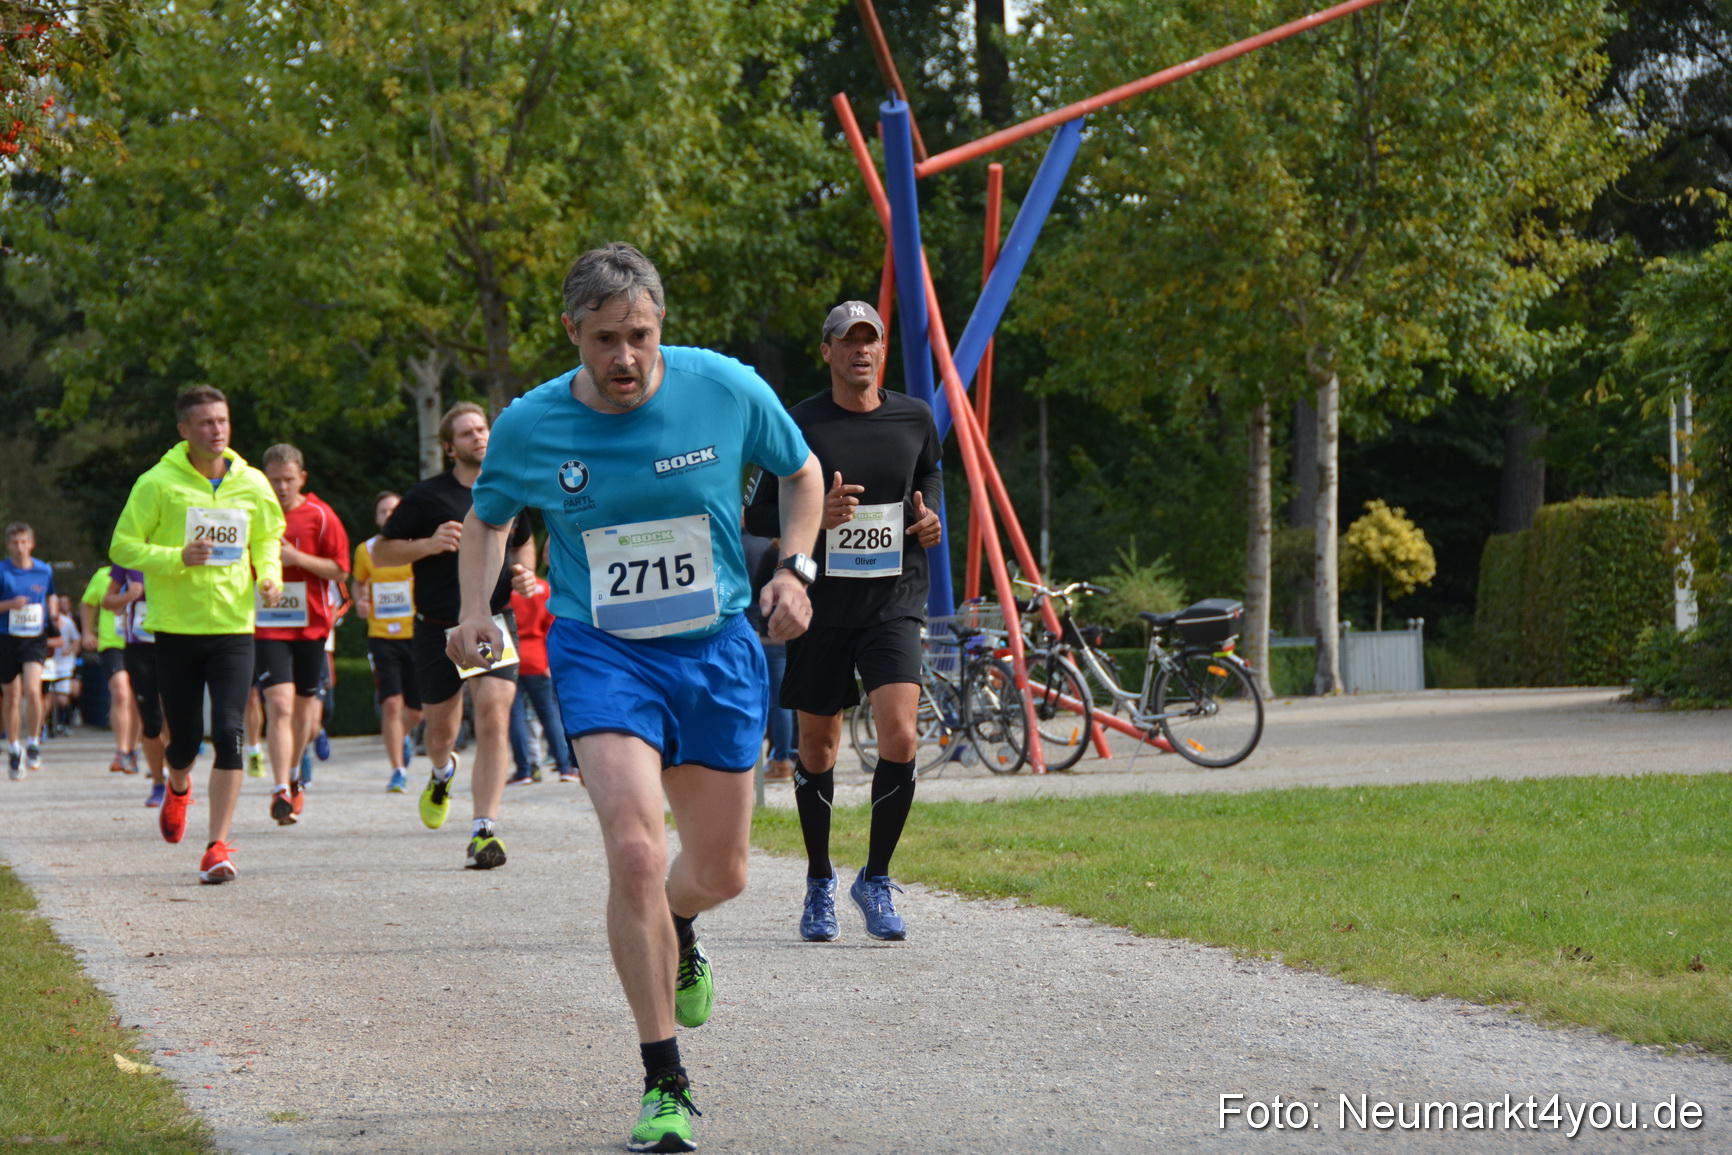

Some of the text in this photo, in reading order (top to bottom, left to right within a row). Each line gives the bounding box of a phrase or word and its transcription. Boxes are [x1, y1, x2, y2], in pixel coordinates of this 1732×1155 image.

[654, 446, 717, 474] BOCK
[563, 495, 595, 508] PARTL
[194, 525, 238, 543] 2468
[631, 530, 675, 545] BOCK
[838, 526, 893, 550] 2286
[855, 557, 877, 566] Oliver
[608, 552, 696, 597] 2715
